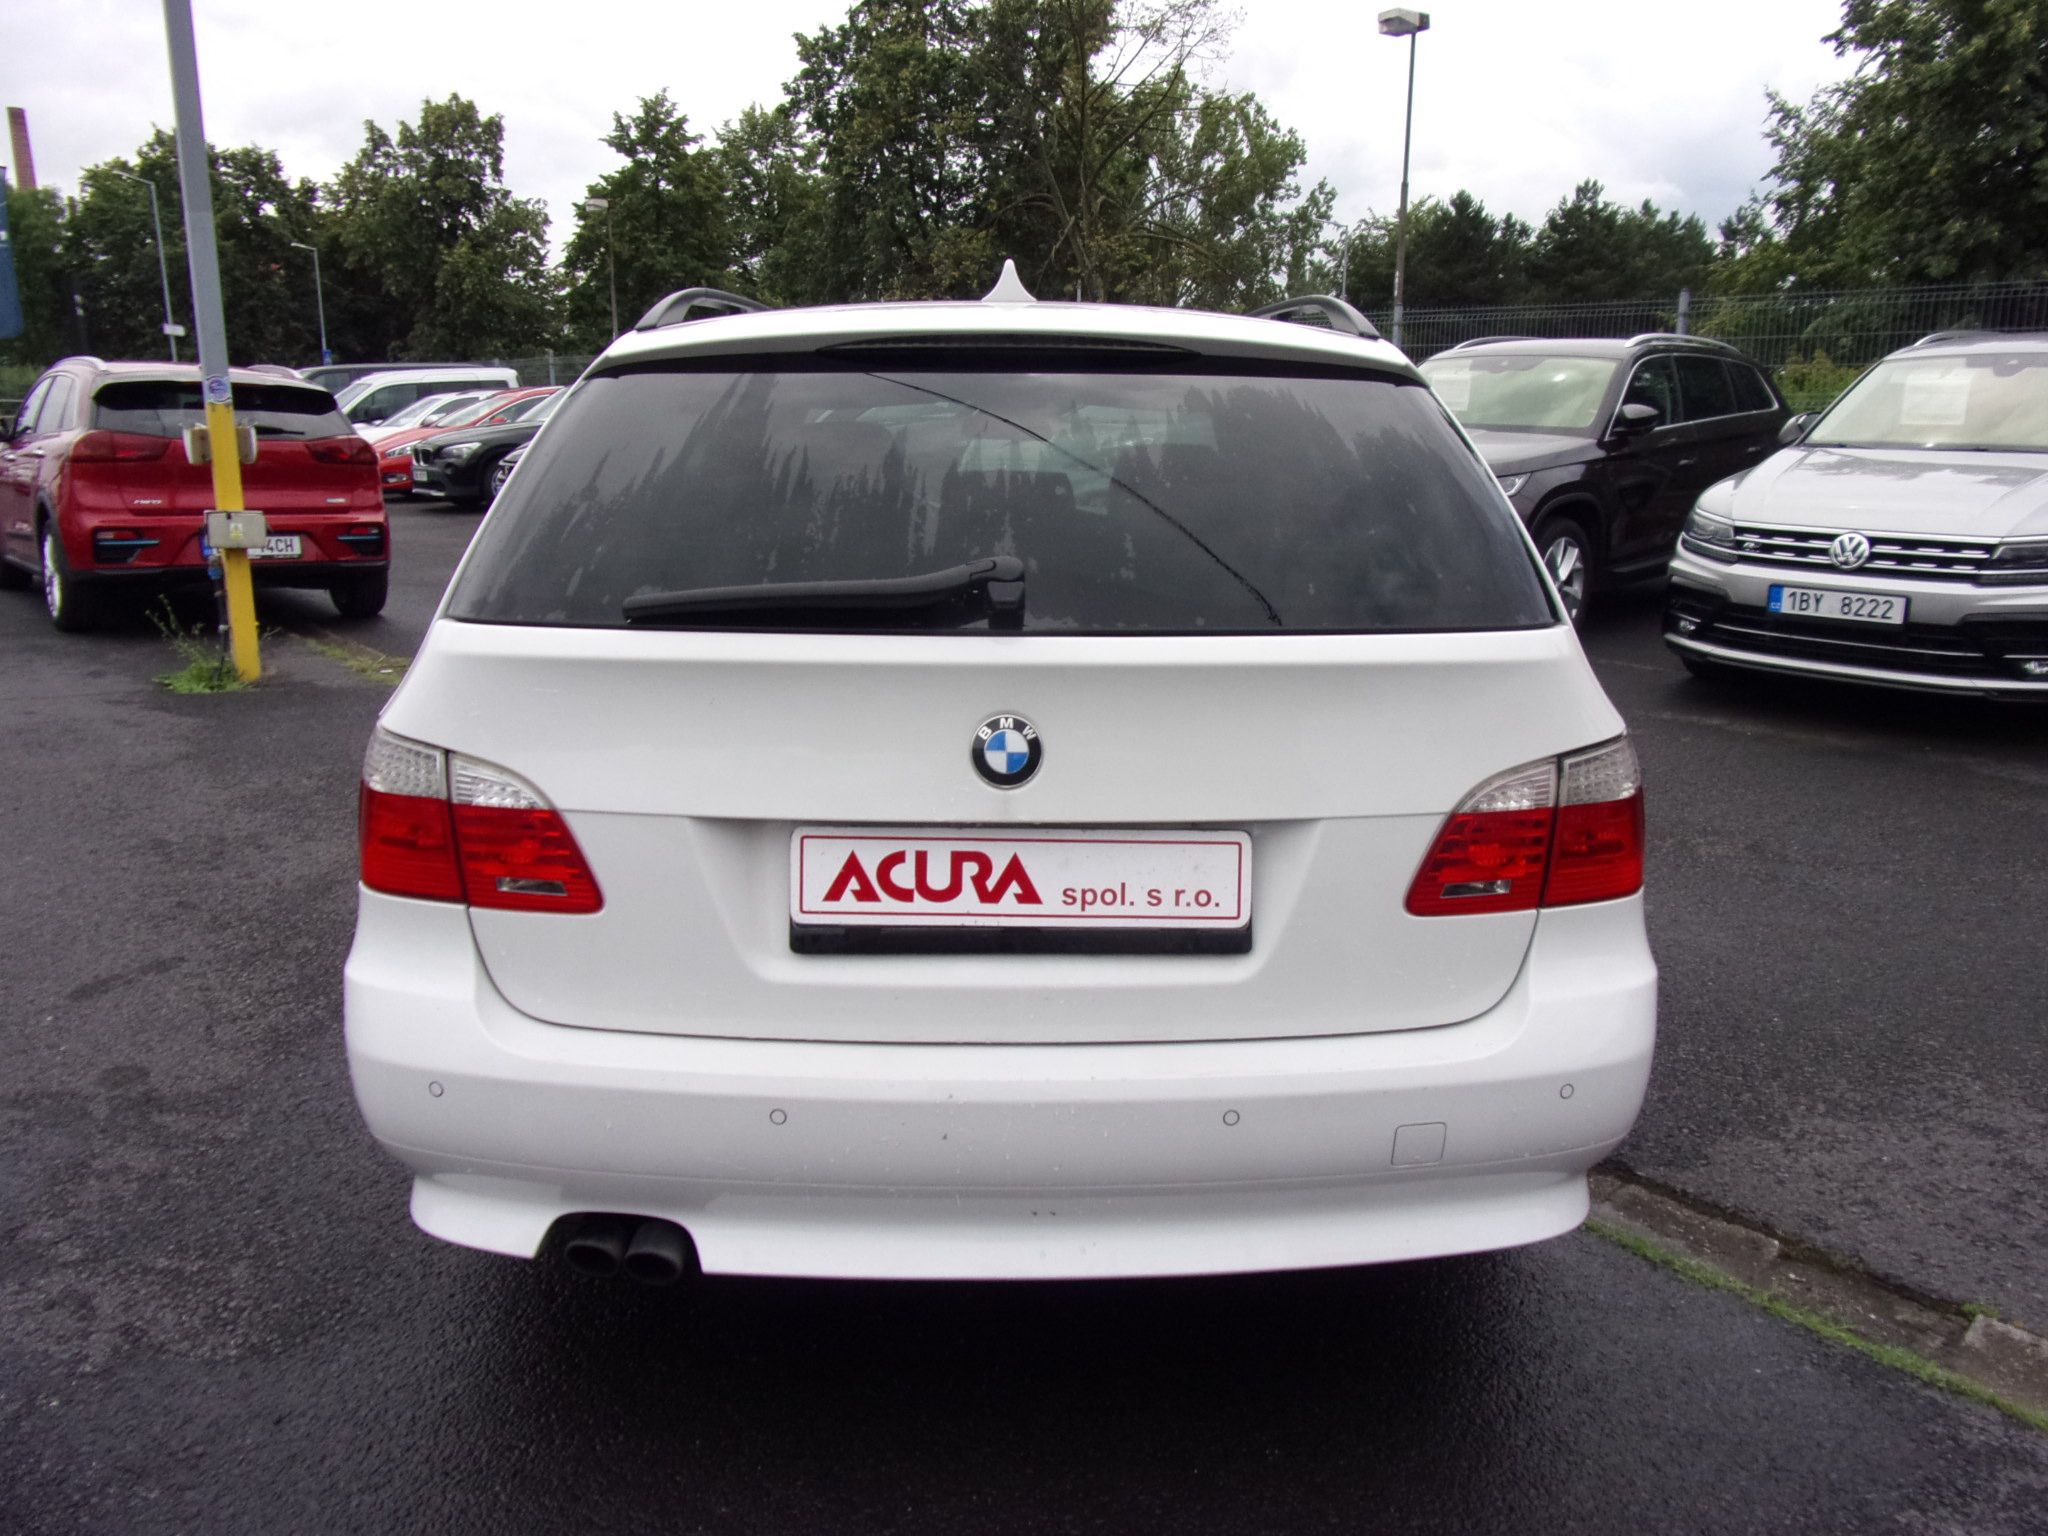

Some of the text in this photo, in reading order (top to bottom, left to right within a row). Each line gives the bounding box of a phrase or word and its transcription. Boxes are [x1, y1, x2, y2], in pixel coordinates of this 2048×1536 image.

[261, 538, 294, 552] 4CH
[1788, 591, 1894, 619] 1BY 8222
[978, 717, 1037, 740] BMW
[822, 849, 1220, 911] ACURA spol. s r.o.
